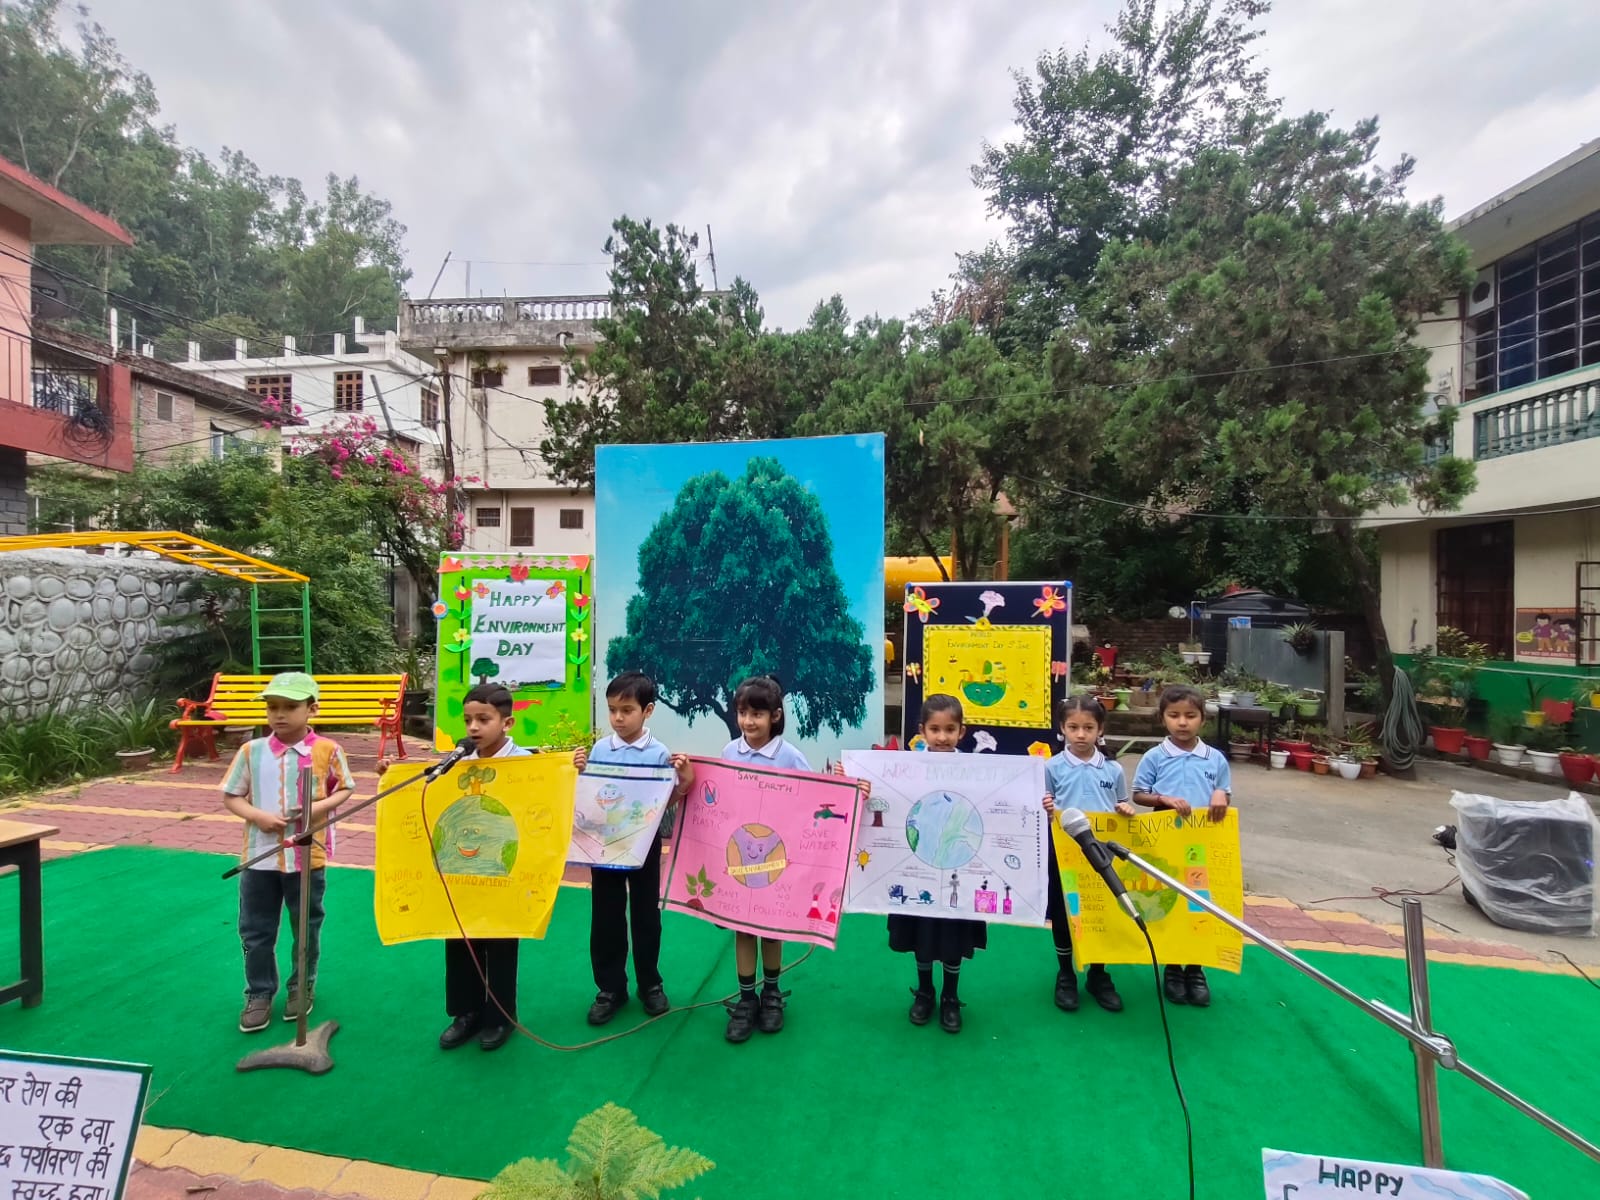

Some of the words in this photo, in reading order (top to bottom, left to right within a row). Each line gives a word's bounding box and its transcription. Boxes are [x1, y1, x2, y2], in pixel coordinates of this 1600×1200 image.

[489, 591, 543, 607] HAPPY
[473, 614, 566, 634] ENVIRONMENT
[496, 639, 534, 656] DAY
[737, 770, 759, 782] SAVE
[758, 782, 793, 793] EARTH
[1099, 780, 1114, 789] DAV
[1127, 814, 1236, 834] ENVIRONMT
[802, 829, 829, 839] SAVE
[1131, 834, 1160, 848] DAY
[799, 840, 839, 851] WATER
[1080, 893, 1104, 902] SAVE
[753, 904, 799, 919] POLLUTION
[21, 1071, 52, 1107] रोग
[55, 1076, 82, 1108] की
[38, 1115, 74, 1141] एक
[19, 1141, 83, 1177] पर्यावरण
[1318, 1158, 1404, 1196] HAPPY
